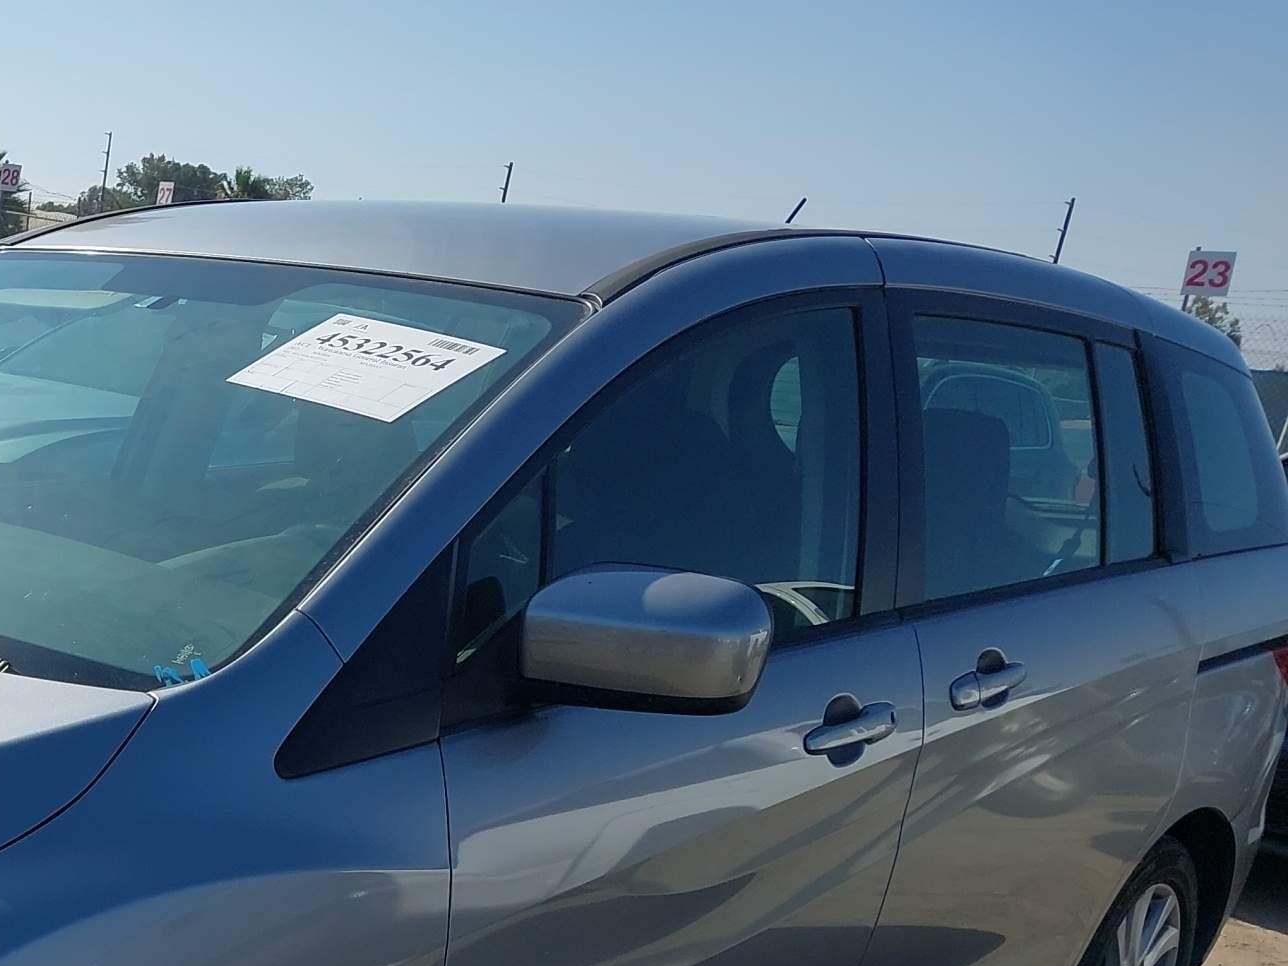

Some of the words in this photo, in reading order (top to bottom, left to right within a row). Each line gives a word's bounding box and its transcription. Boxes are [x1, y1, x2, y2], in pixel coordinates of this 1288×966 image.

[1, 168, 21, 186] 28
[159, 187, 173, 204] 27
[1185, 259, 1231, 288] 23
[315, 332, 457, 372] 45322564
